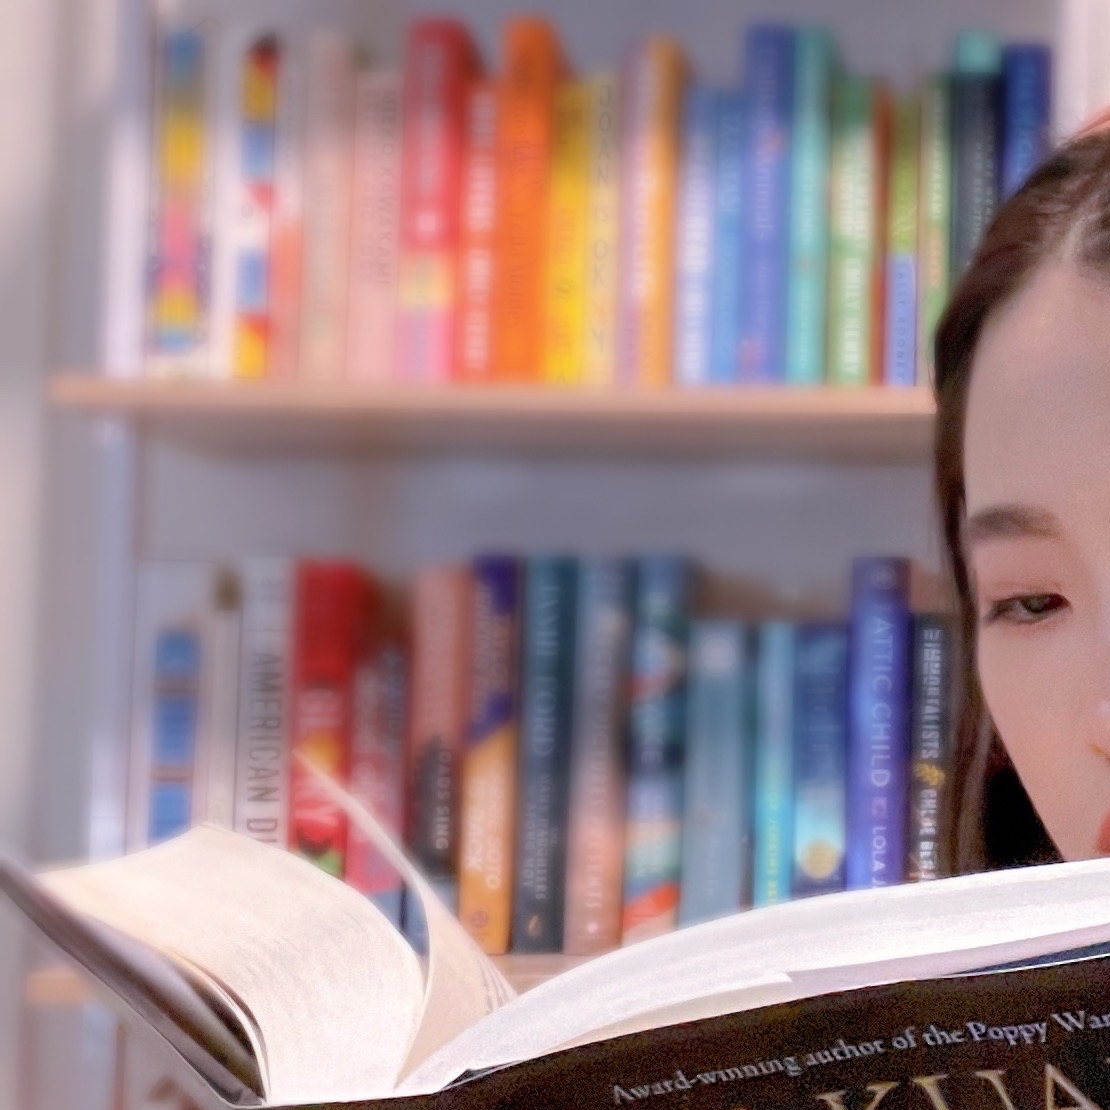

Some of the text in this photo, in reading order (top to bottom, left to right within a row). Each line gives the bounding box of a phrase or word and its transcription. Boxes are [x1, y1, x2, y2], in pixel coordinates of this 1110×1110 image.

[750, 46, 778, 139] Unlikely
[377, 166, 395, 287] KAWAKAMI
[467, 156, 495, 232] LOVERS
[633, 171, 655, 241] Real
[752, 152, 777, 241] Animals
[467, 247, 492, 306] EMILY
[631, 249, 653, 299] Life
[464, 312, 491, 372] HENRY
[843, 258, 861, 376] EMILY HENRY
[894, 317, 908, 381] ROONEY
[471, 580, 493, 725] JENKINS REID
[490, 612, 511, 695] TAYLOR
[246, 651, 284, 803] AMERICAN
[530, 676, 558, 757] FORD
[871, 614, 892, 872] ATTIC CHILD LOLA
[588, 712, 612, 806] PICTURES
[435, 806, 450, 850] SING
[465, 807, 487, 872] BACK
[485, 835, 504, 891] SOTO
[584, 816, 607, 909] PRESENTS
[610, 1054, 801, 1105] Award-winning
[806, 1039, 885, 1067] author
[892, 1025, 916, 1050] of
[922, 1024, 965, 1047] the
[966, 1020, 1048, 1046] Poppy
